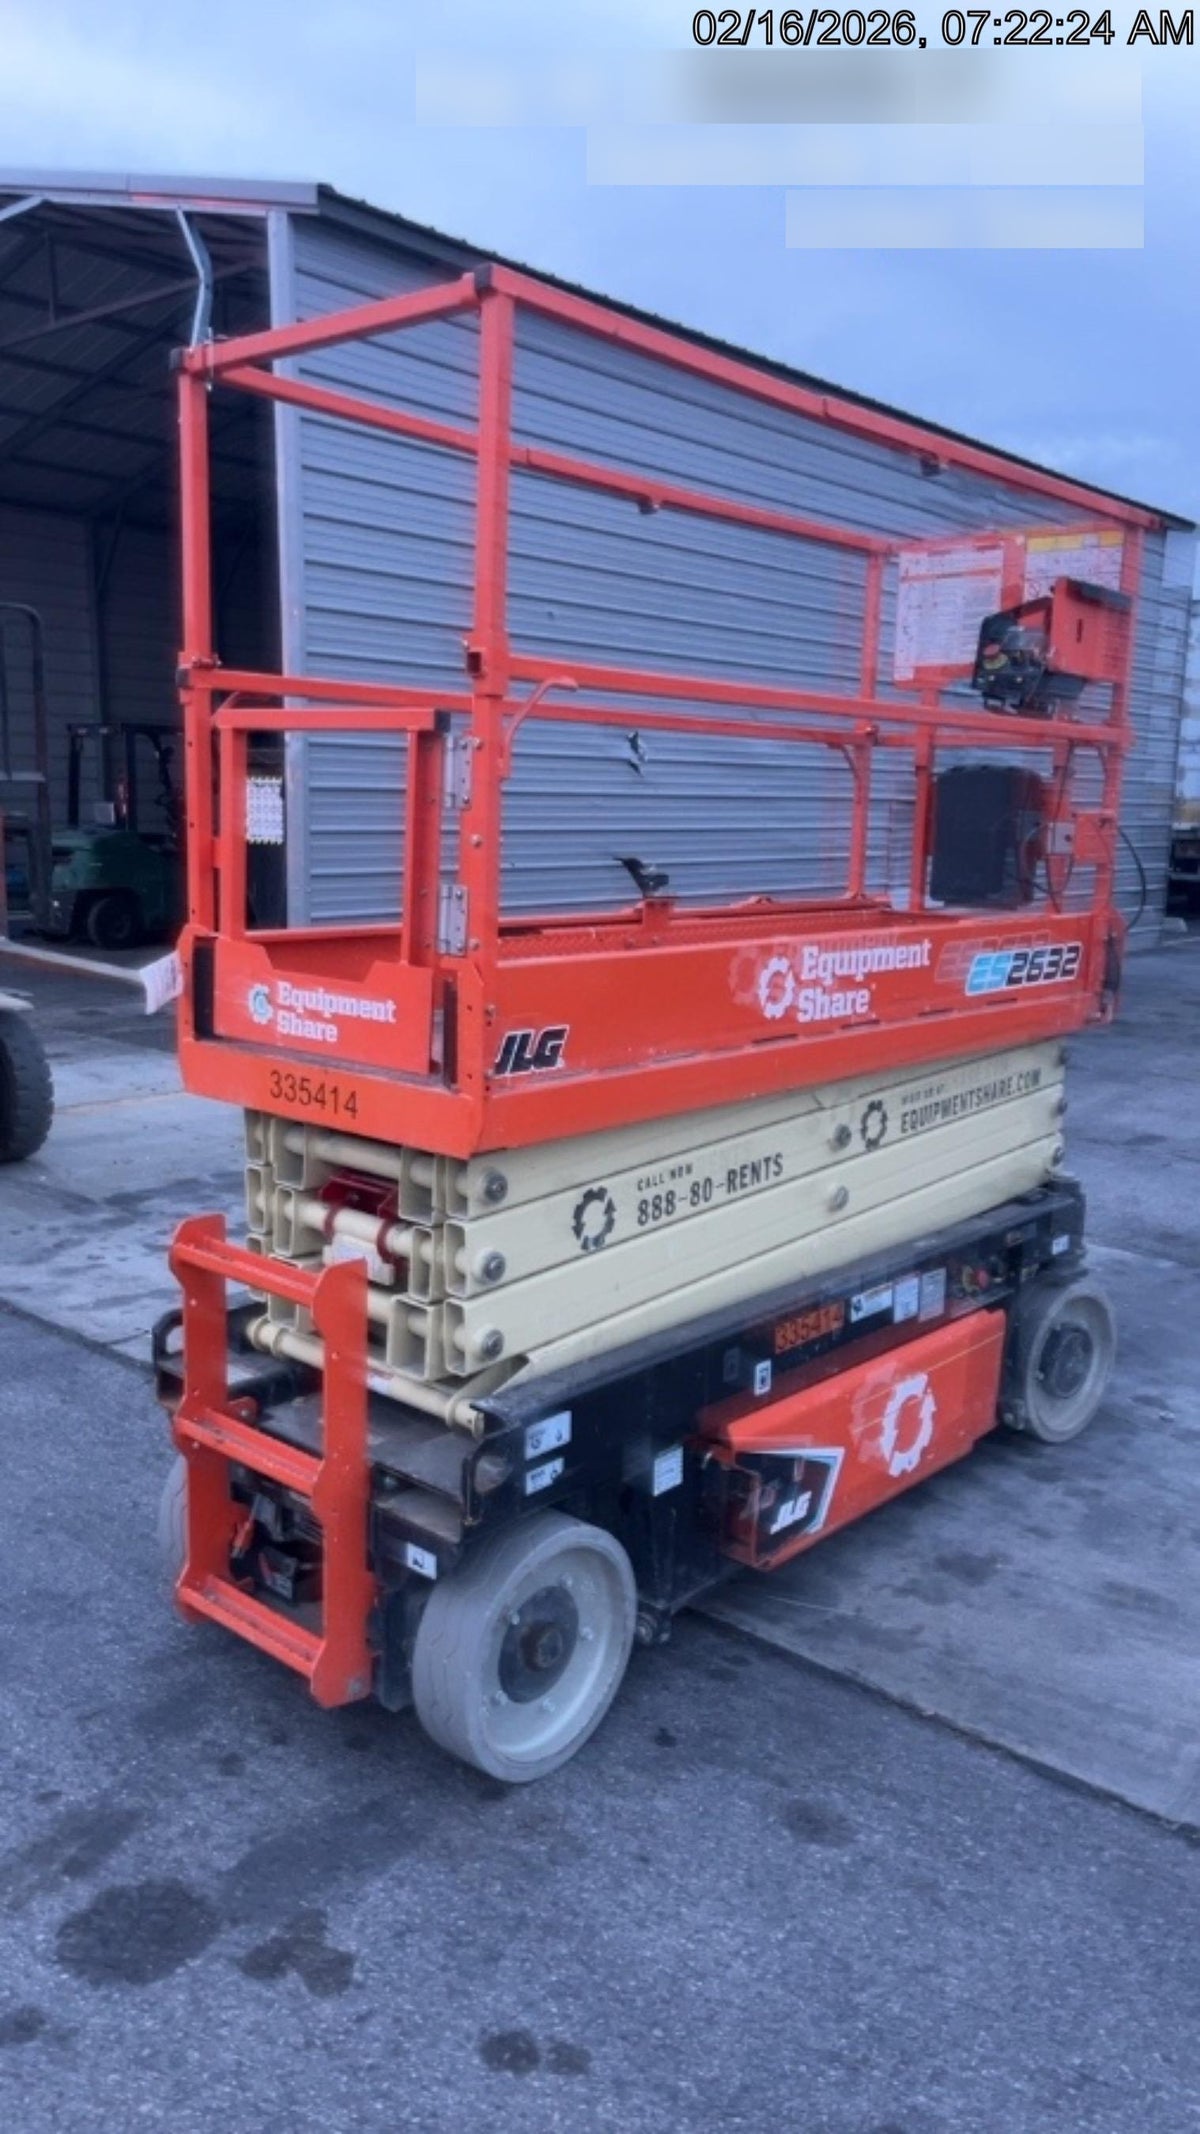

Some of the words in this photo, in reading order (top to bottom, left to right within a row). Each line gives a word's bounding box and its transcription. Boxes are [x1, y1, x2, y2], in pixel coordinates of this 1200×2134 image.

[801, 938, 932, 985] Equipment
[967, 943, 1082, 995] ES2632
[277, 980, 397, 1024] Equipment
[797, 985, 871, 1023] Share
[277, 1009, 338, 1043] Share
[491, 1024, 569, 1078] JLG
[269, 1069, 359, 1120] 335414
[901, 1067, 1041, 1134] EQUIPMENTSHARE.COM
[637, 1173, 665, 1191] CALL
[637, 1152, 784, 1226] 888-80-RENTS
[769, 1490, 813, 1535] JLG
